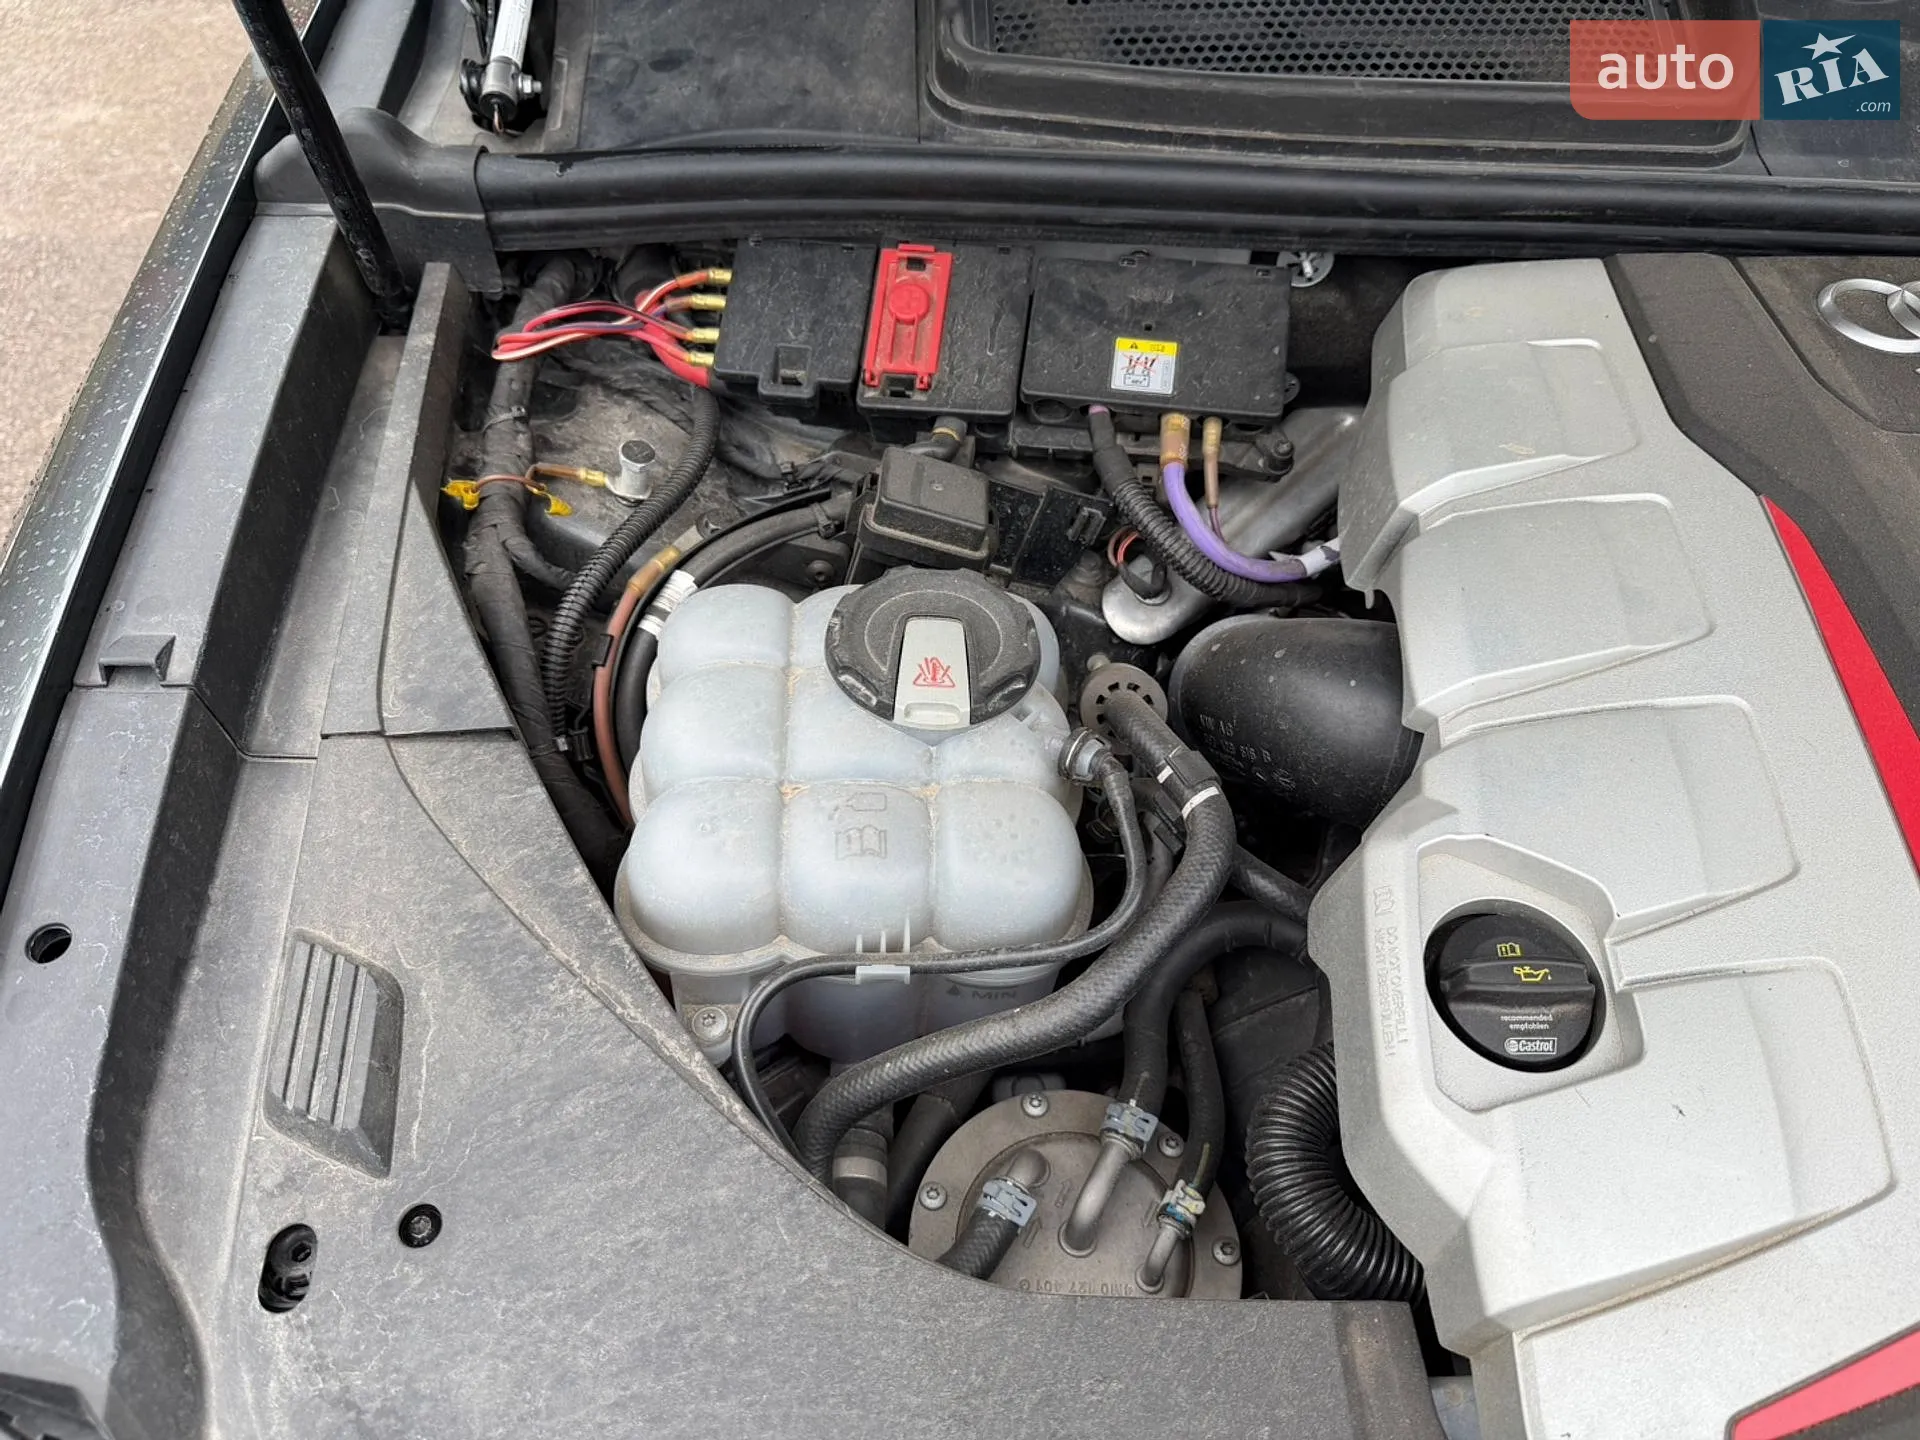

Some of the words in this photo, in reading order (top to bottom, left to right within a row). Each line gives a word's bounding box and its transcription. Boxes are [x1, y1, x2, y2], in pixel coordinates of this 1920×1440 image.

[971, 989, 1017, 1000] MIN
[1500, 1013, 1553, 1022] recommended
[1509, 1022, 1550, 1031] empfohlen
[1519, 1039, 1553, 1052] Castrol
